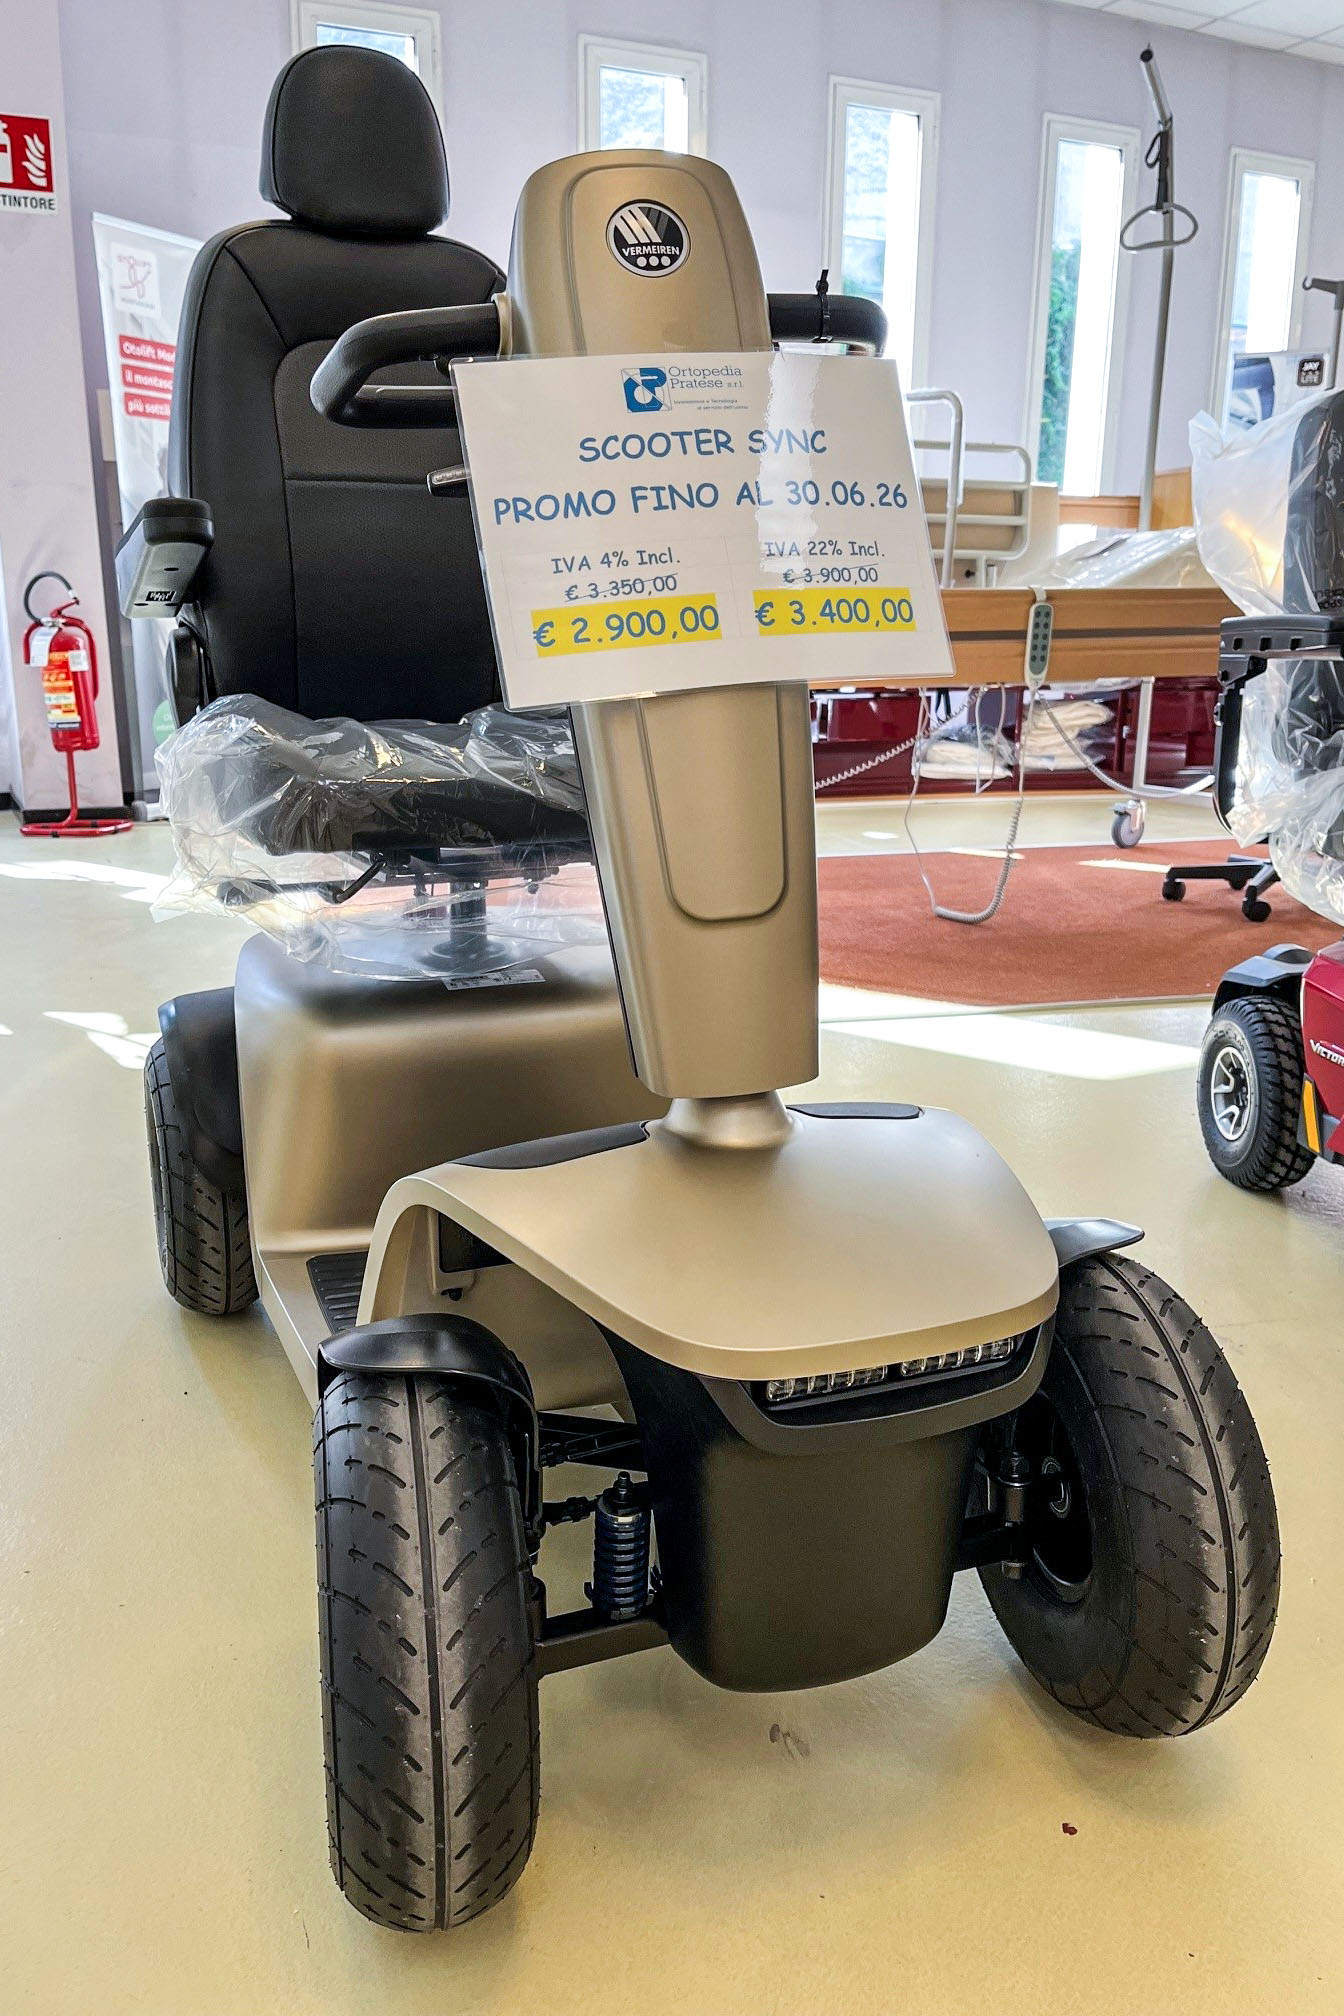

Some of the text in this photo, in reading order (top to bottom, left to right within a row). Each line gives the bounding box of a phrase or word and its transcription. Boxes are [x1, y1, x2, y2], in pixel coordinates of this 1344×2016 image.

[622, 245, 680, 257] VERMEIREN
[668, 365, 742, 379] Ortopedia
[670, 378, 723, 389] Pratese
[579, 428, 828, 462] SCOOTER SYNC
[494, 480, 908, 525] PROMO FINO AL 30.06.26
[551, 547, 681, 574] IVA 4% Incl.
[764, 539, 885, 557] IVA 22% Incl.
[565, 574, 678, 601] € 3.350,00
[783, 567, 879, 585] € 3.900,00
[532, 604, 720, 648] € 2.900,00
[754, 598, 914, 628] € 3.400,00
